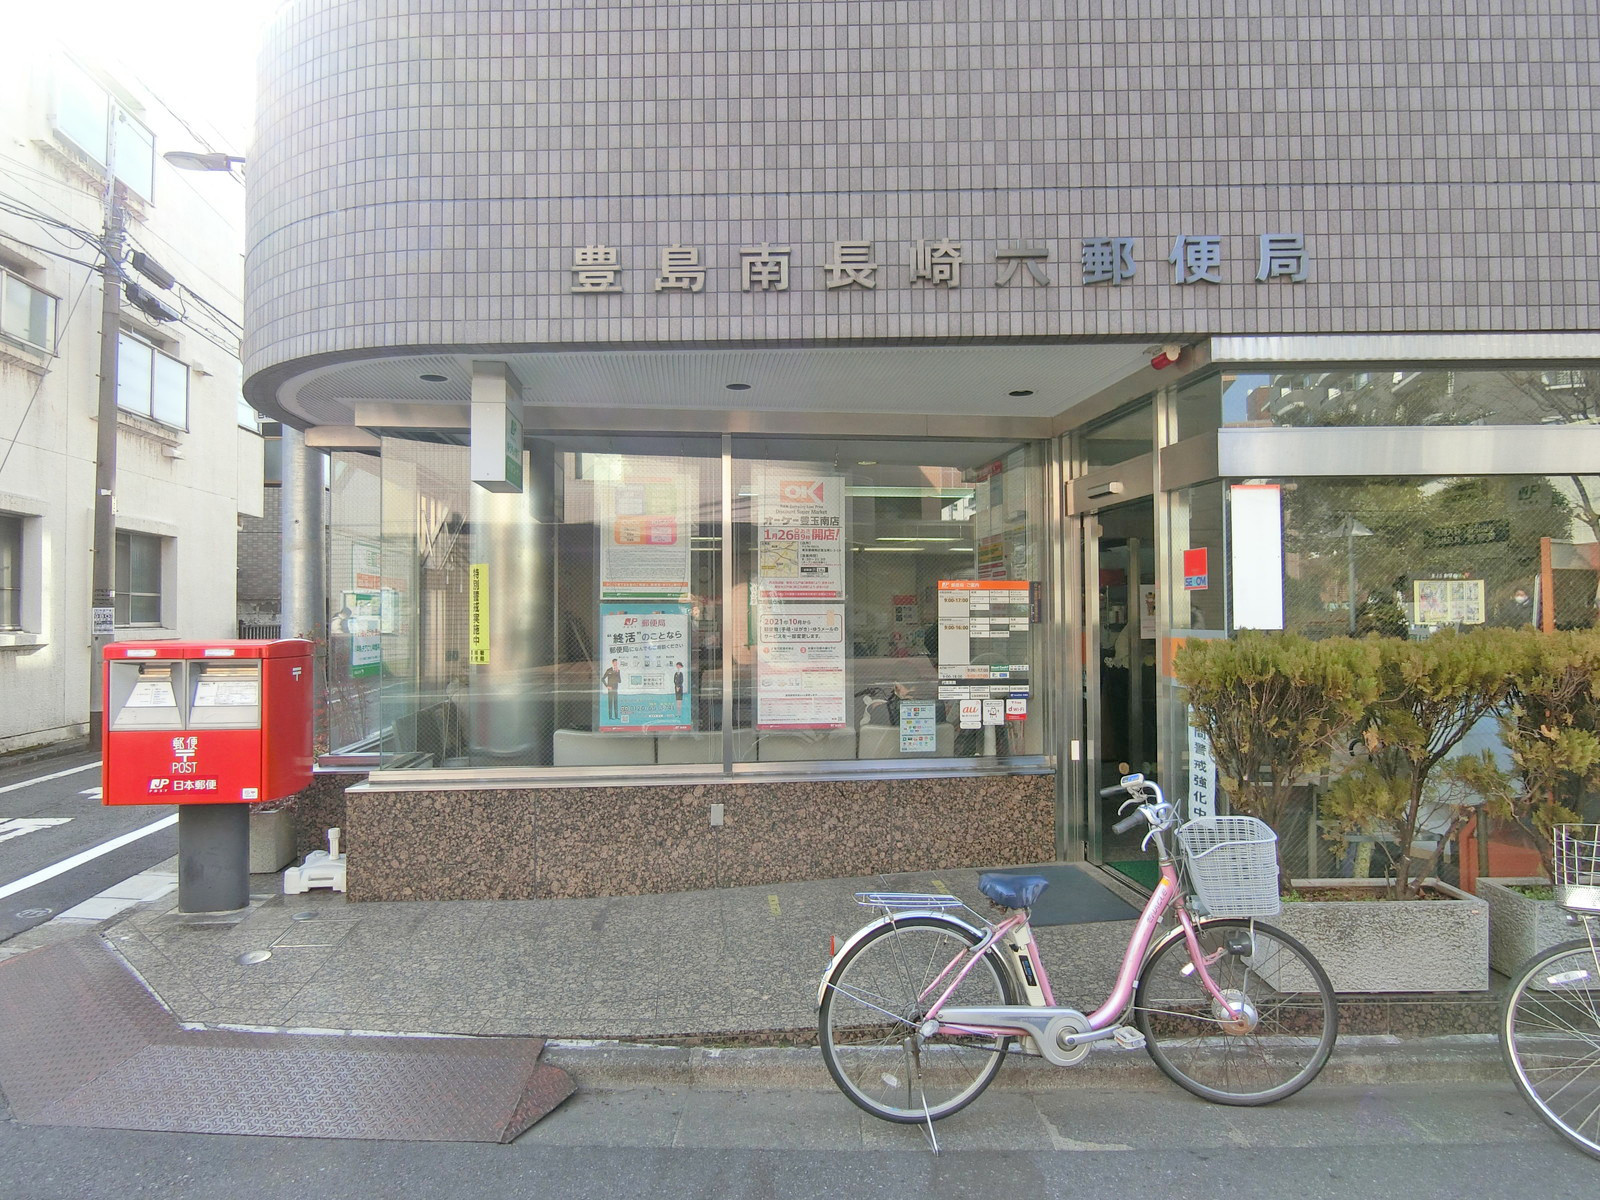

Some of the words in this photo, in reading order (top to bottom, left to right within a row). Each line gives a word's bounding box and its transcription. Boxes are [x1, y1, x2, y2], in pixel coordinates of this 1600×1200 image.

[571, 233, 1310, 293] 豊島南長崎六郵便局
[783, 481, 823, 503] OK
[1185, 576, 1206, 587] SEOM
[641, 619, 666, 627] 郵便局
[173, 736, 198, 750] 郵便
[172, 762, 198, 773] POST
[173, 780, 217, 791] 日本郵便
